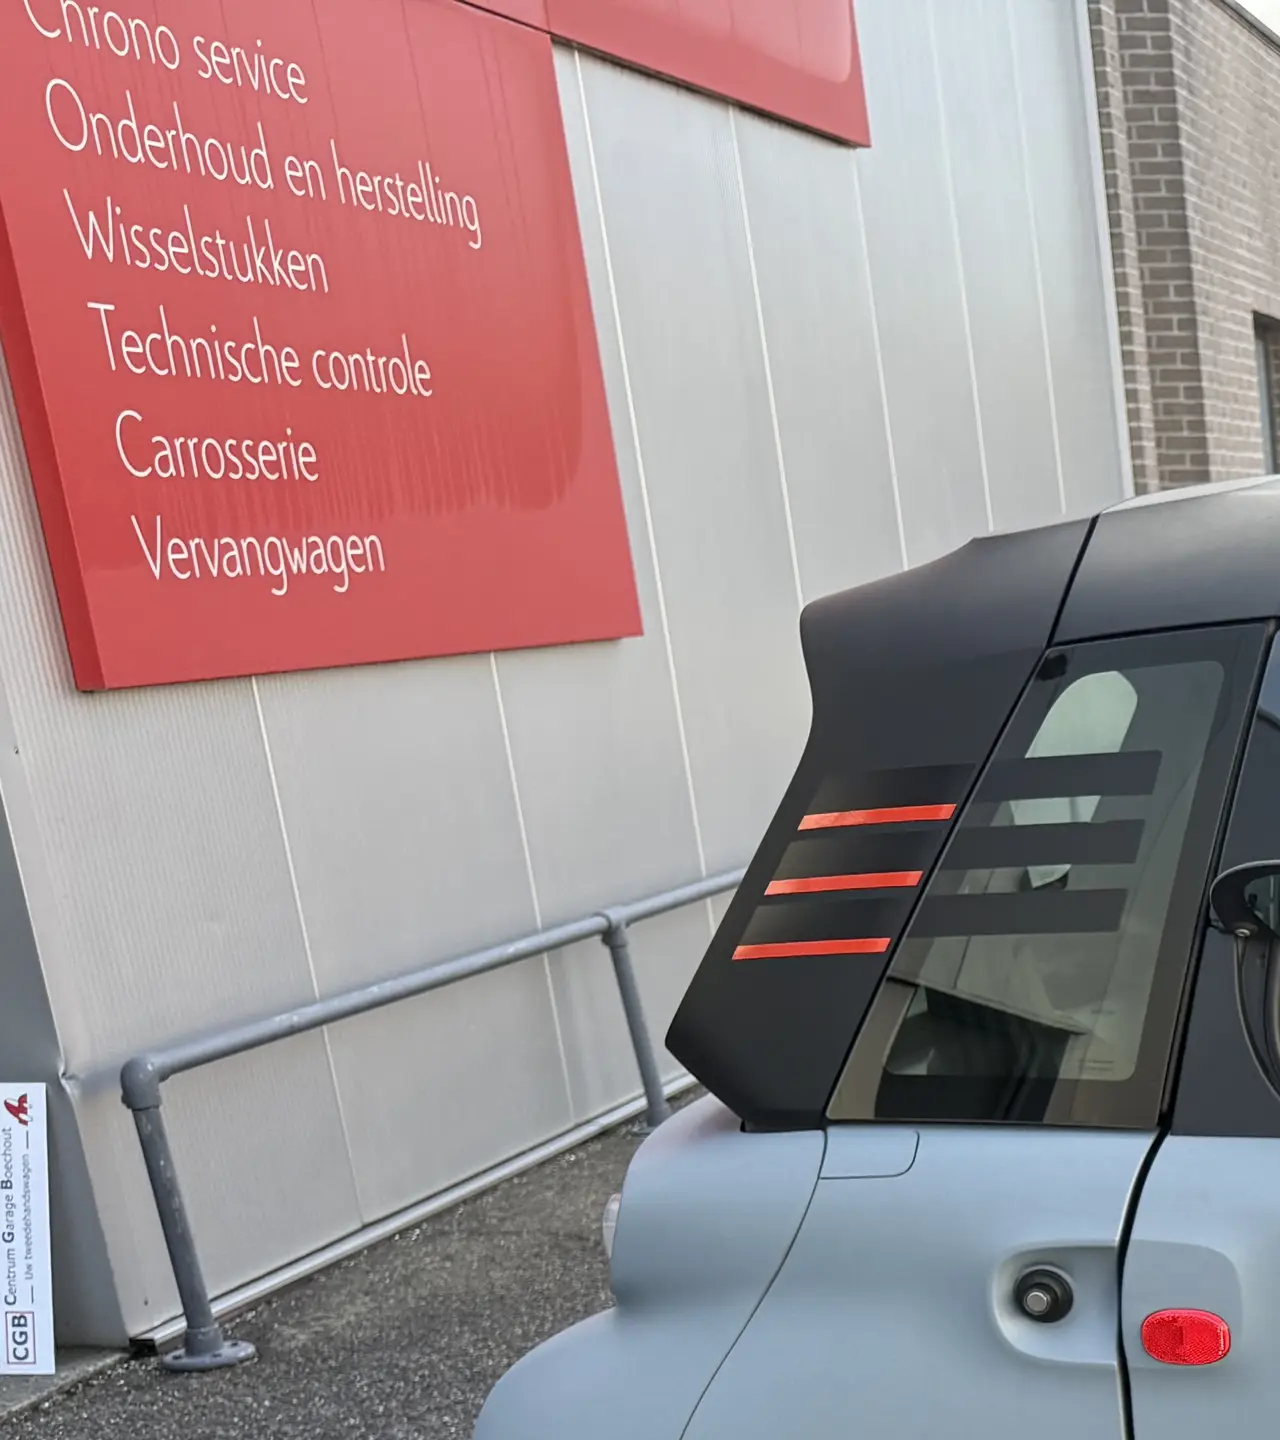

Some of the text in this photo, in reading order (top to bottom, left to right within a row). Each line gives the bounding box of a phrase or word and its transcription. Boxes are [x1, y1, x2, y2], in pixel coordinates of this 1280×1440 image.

[23, 0, 308, 104] Chrono service
[45, 78, 482, 250] Onderhoud en herstelling
[63, 188, 329, 293] Wisselstukken
[87, 301, 433, 397] Technische controle
[115, 409, 319, 482] Carrosserie
[131, 515, 385, 596] Vervangwagen
[2, 1194, 17, 1243] Garage
[4, 1248, 18, 1306] Centrum
[11, 1313, 29, 1362] CGB
